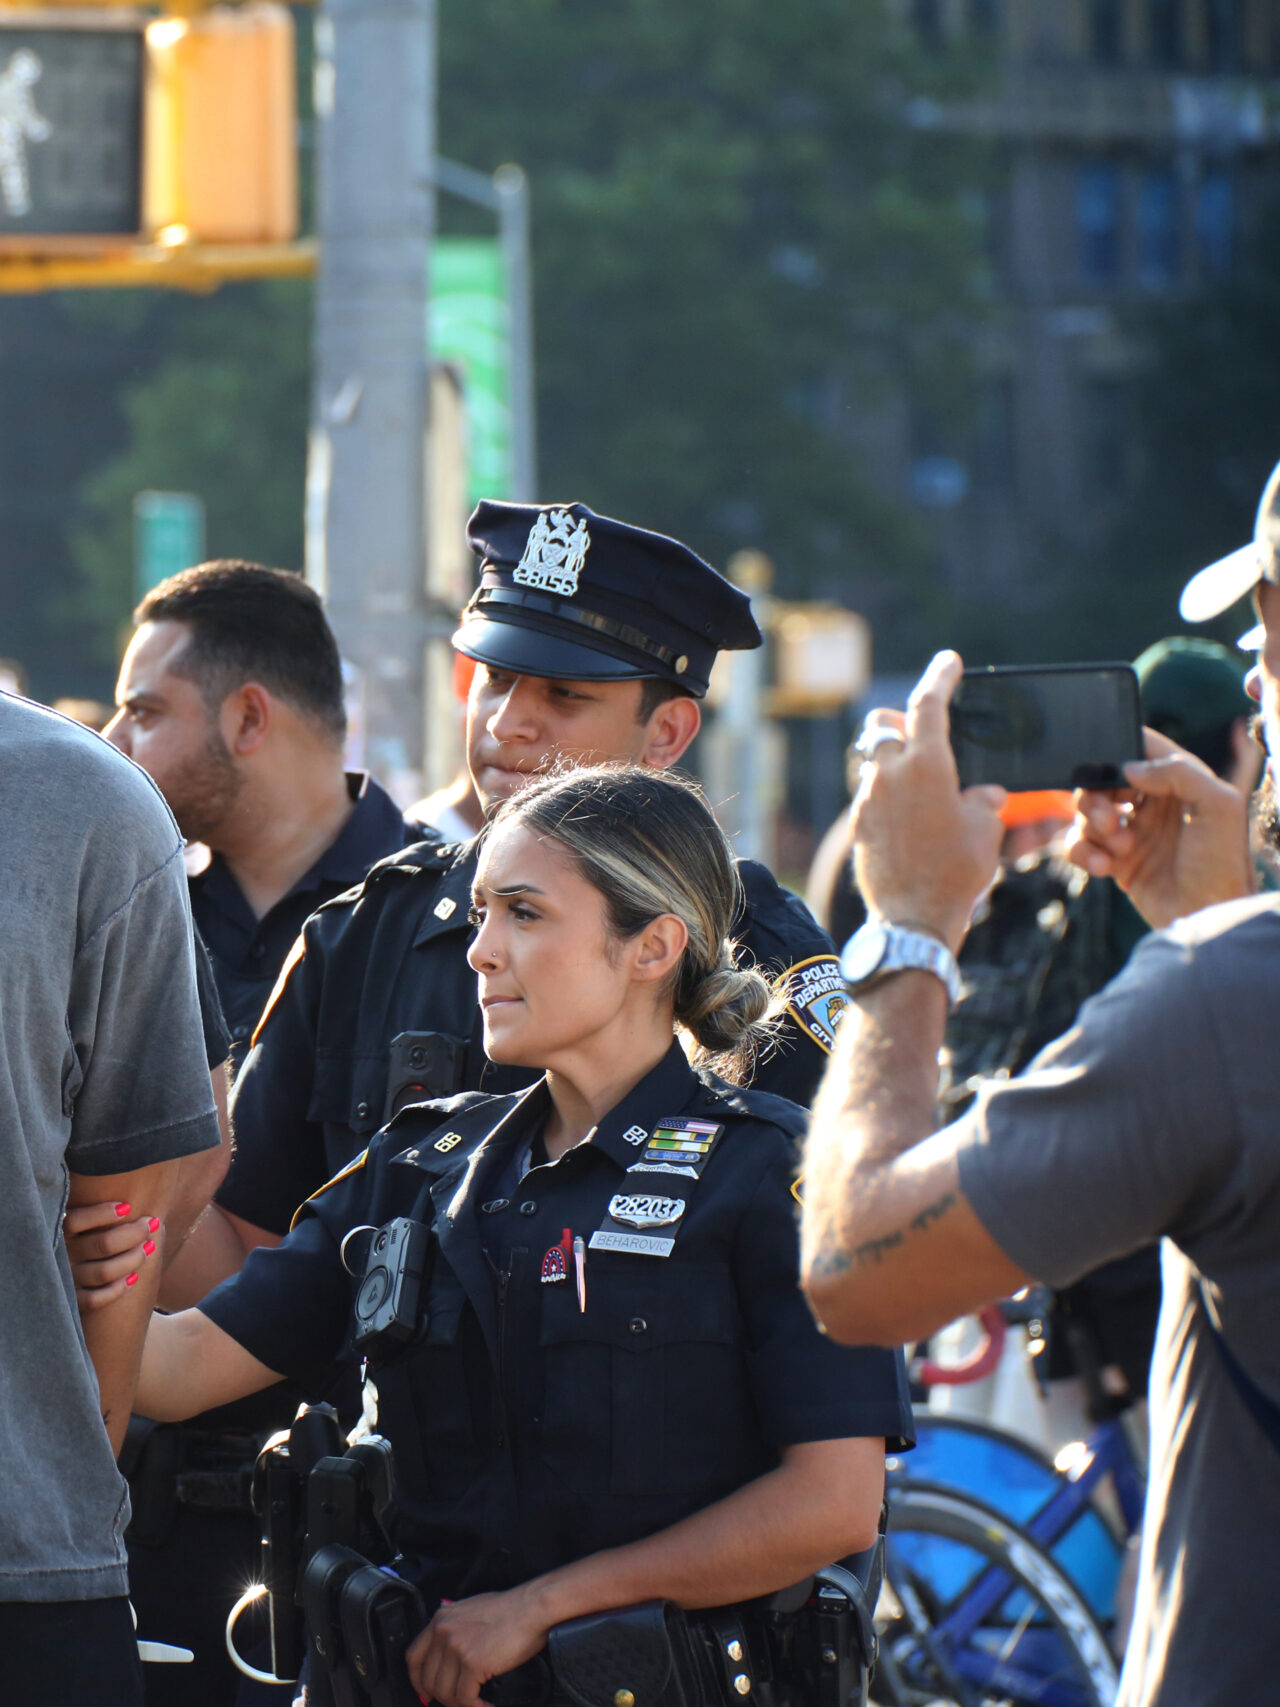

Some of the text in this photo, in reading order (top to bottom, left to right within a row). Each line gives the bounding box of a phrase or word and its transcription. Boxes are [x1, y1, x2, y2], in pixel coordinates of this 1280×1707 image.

[513, 568, 578, 596] 28156
[801, 963, 839, 985] POLICE
[434, 1132, 462, 1152] 66
[615, 1195, 673, 1218] 28203
[596, 1234, 669, 1251] BEHAROVIC
